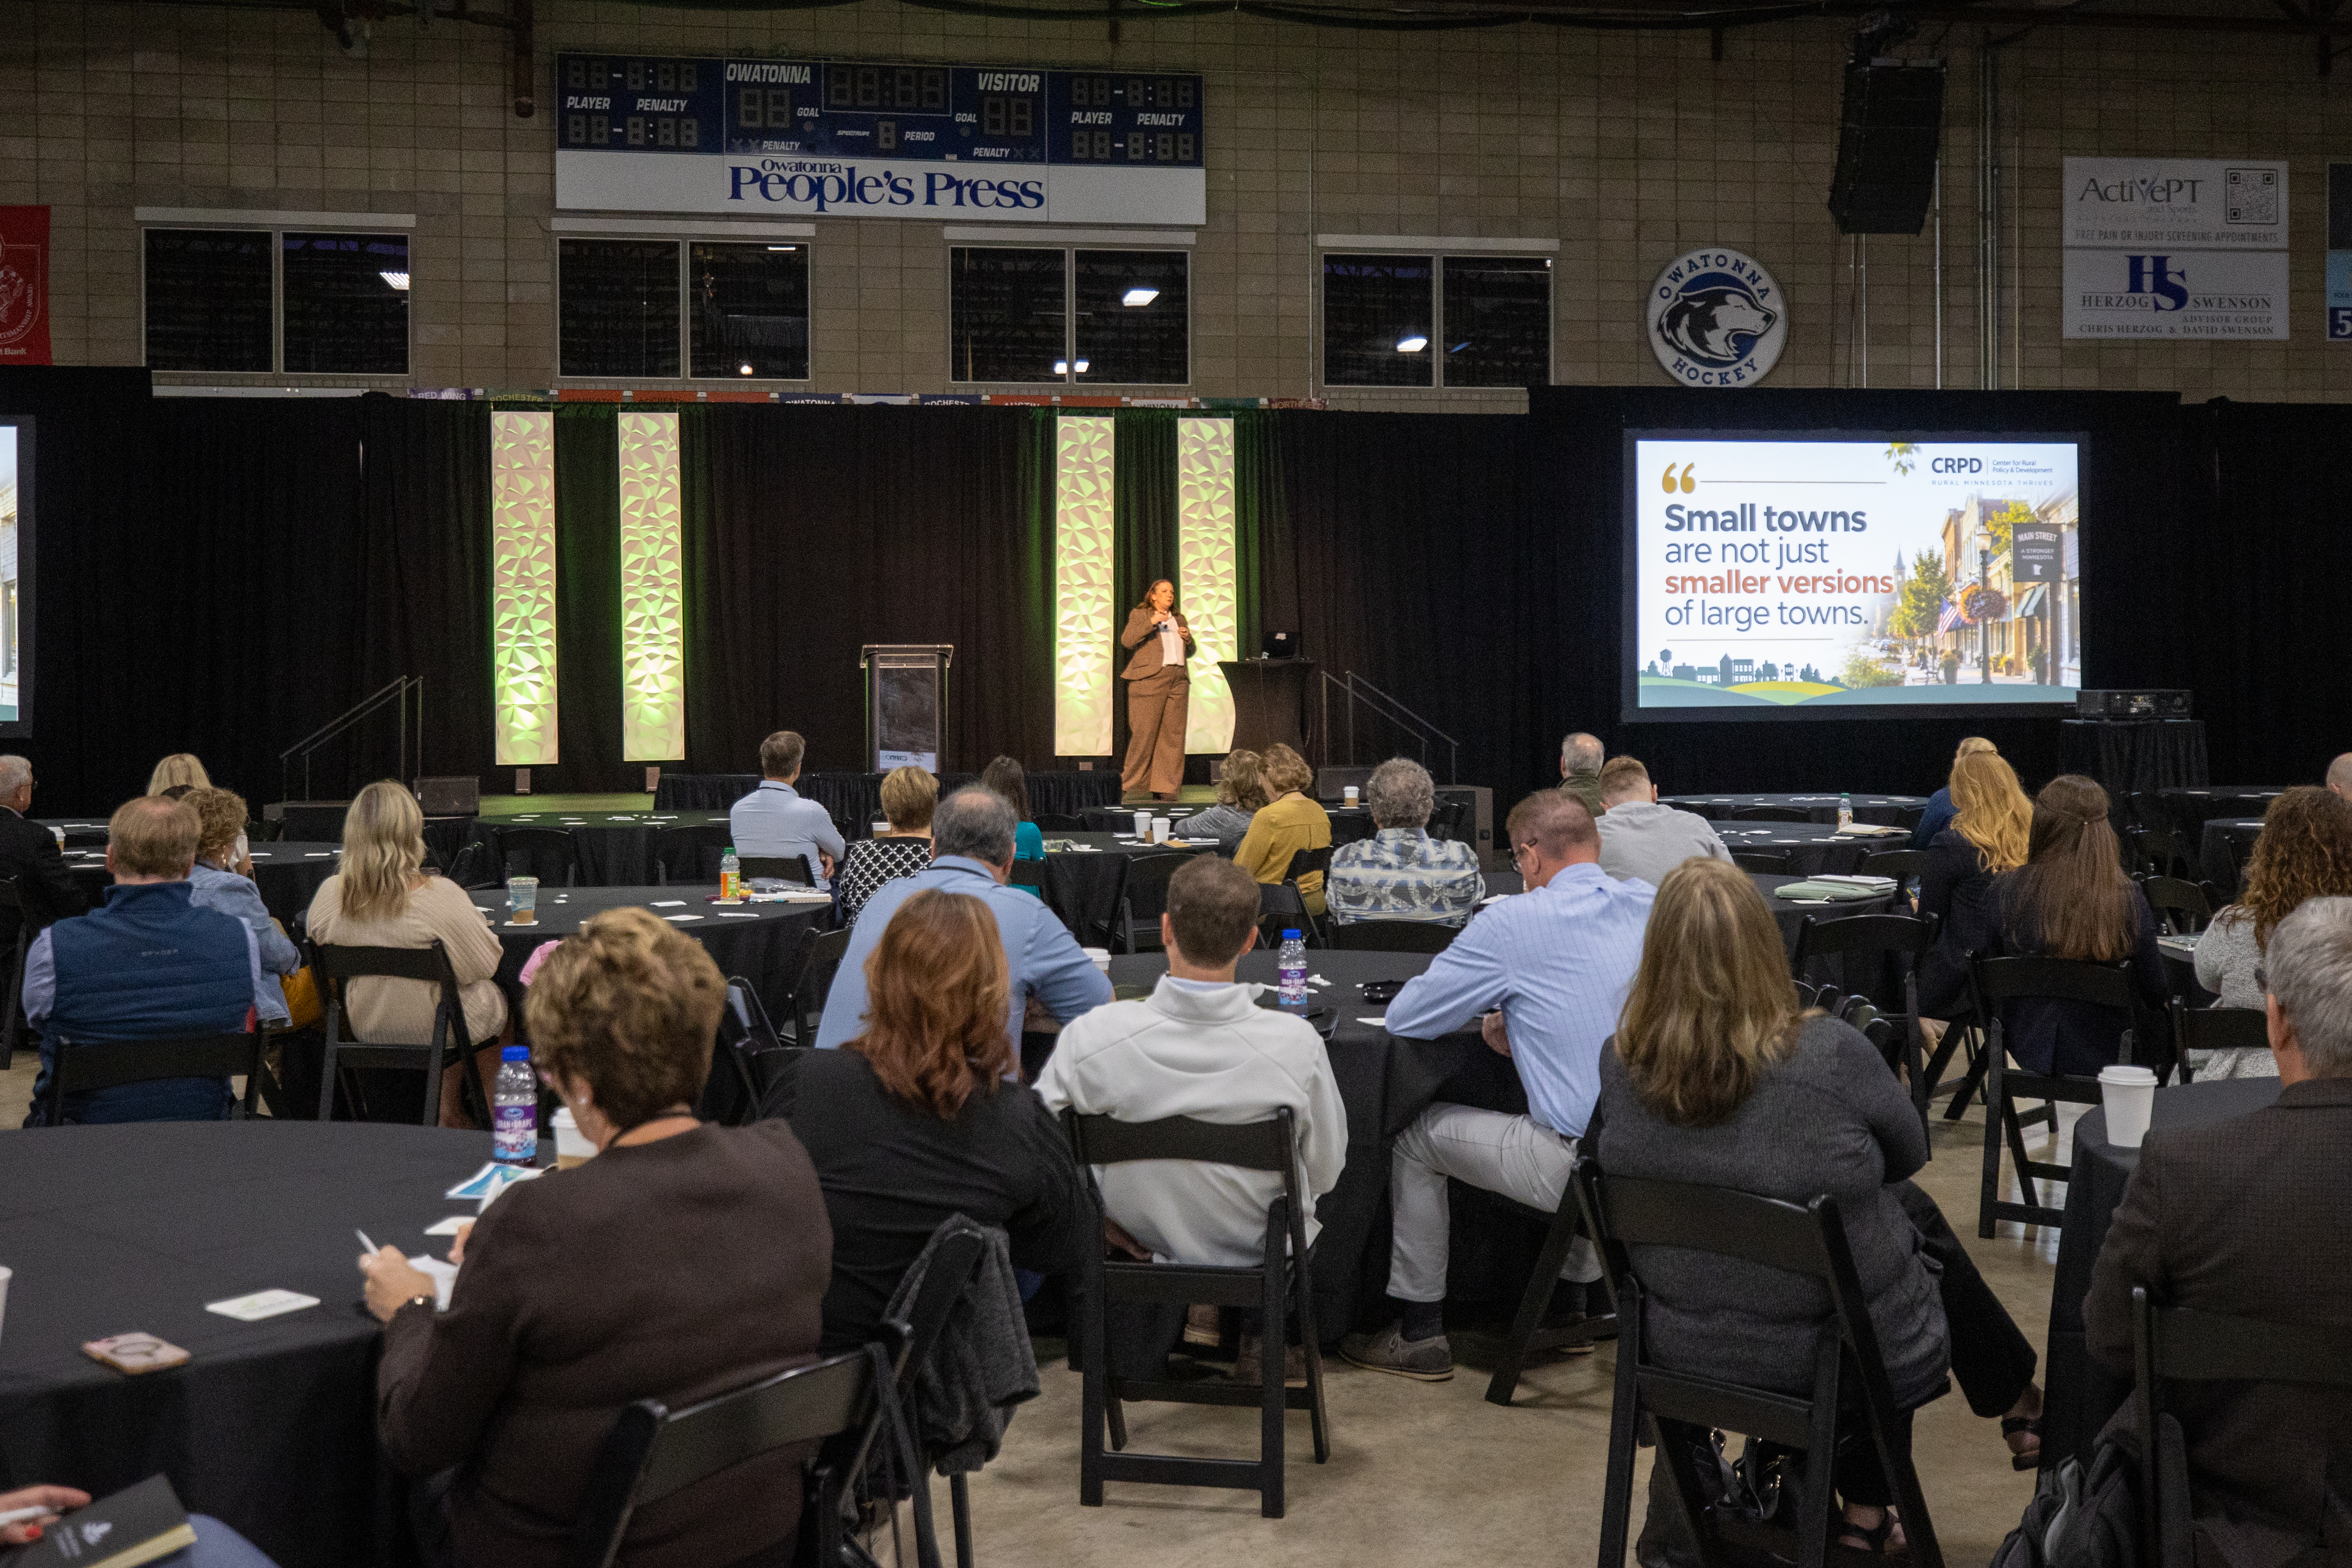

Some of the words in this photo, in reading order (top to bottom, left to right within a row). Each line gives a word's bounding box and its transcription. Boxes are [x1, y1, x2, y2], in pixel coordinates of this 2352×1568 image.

[726, 63, 810, 84] OWATONNA
[978, 73, 1040, 92] VISITOR
[567, 96, 610, 110] PLAYER
[637, 98, 688, 112] PENALTY
[797, 107, 819, 118] GOAL
[955, 113, 977, 123] GOAL
[1071, 111, 1112, 124] PLAYER
[1137, 114, 1185, 126] PENALTY
[904, 131, 935, 142] PERIOD
[762, 141, 799, 151] PENALTY
[973, 147, 1010, 158] PENALTY
[761, 159, 841, 174] Owatonna
[728, 166, 915, 212] People's
[923, 172, 1045, 209] Press
[2076, 230, 2095, 241] FREE
[2098, 230, 2118, 241] PAIN
[2121, 230, 2132, 241] OR
[2167, 231, 2213, 242] SCREENING
[2215, 232, 2279, 243] APPOINTMENTS
[1659, 254, 1770, 300] OWATONNA
[2081, 295, 2149, 308] HERZOG
[2193, 297, 2272, 309] SWENSON
[2079, 324, 2113, 333] CHRIS
[2117, 325, 2163, 334] HERZOG
[2183, 325, 2218, 334] DAVID
[2221, 326, 2274, 335] SWENSON
[1672, 357, 1758, 386] HOCKEY
[440, 391, 466, 400] WING
[1932, 457, 1983, 473] CRPD
[1664, 503, 1756, 533] Small
[1764, 506, 1867, 533] towns
[2017, 532, 2034, 542] MAIN
[2035, 531, 2057, 542] STREET
[1665, 542, 1712, 563] are
[1721, 539, 1770, 563] not
[1775, 536, 1830, 571] just
[1665, 570, 1772, 594] smaller
[1777, 569, 1895, 594] versions
[1665, 599, 1695, 626] of
[1701, 599, 1771, 632] large
[1777, 603, 1869, 625] towns.
